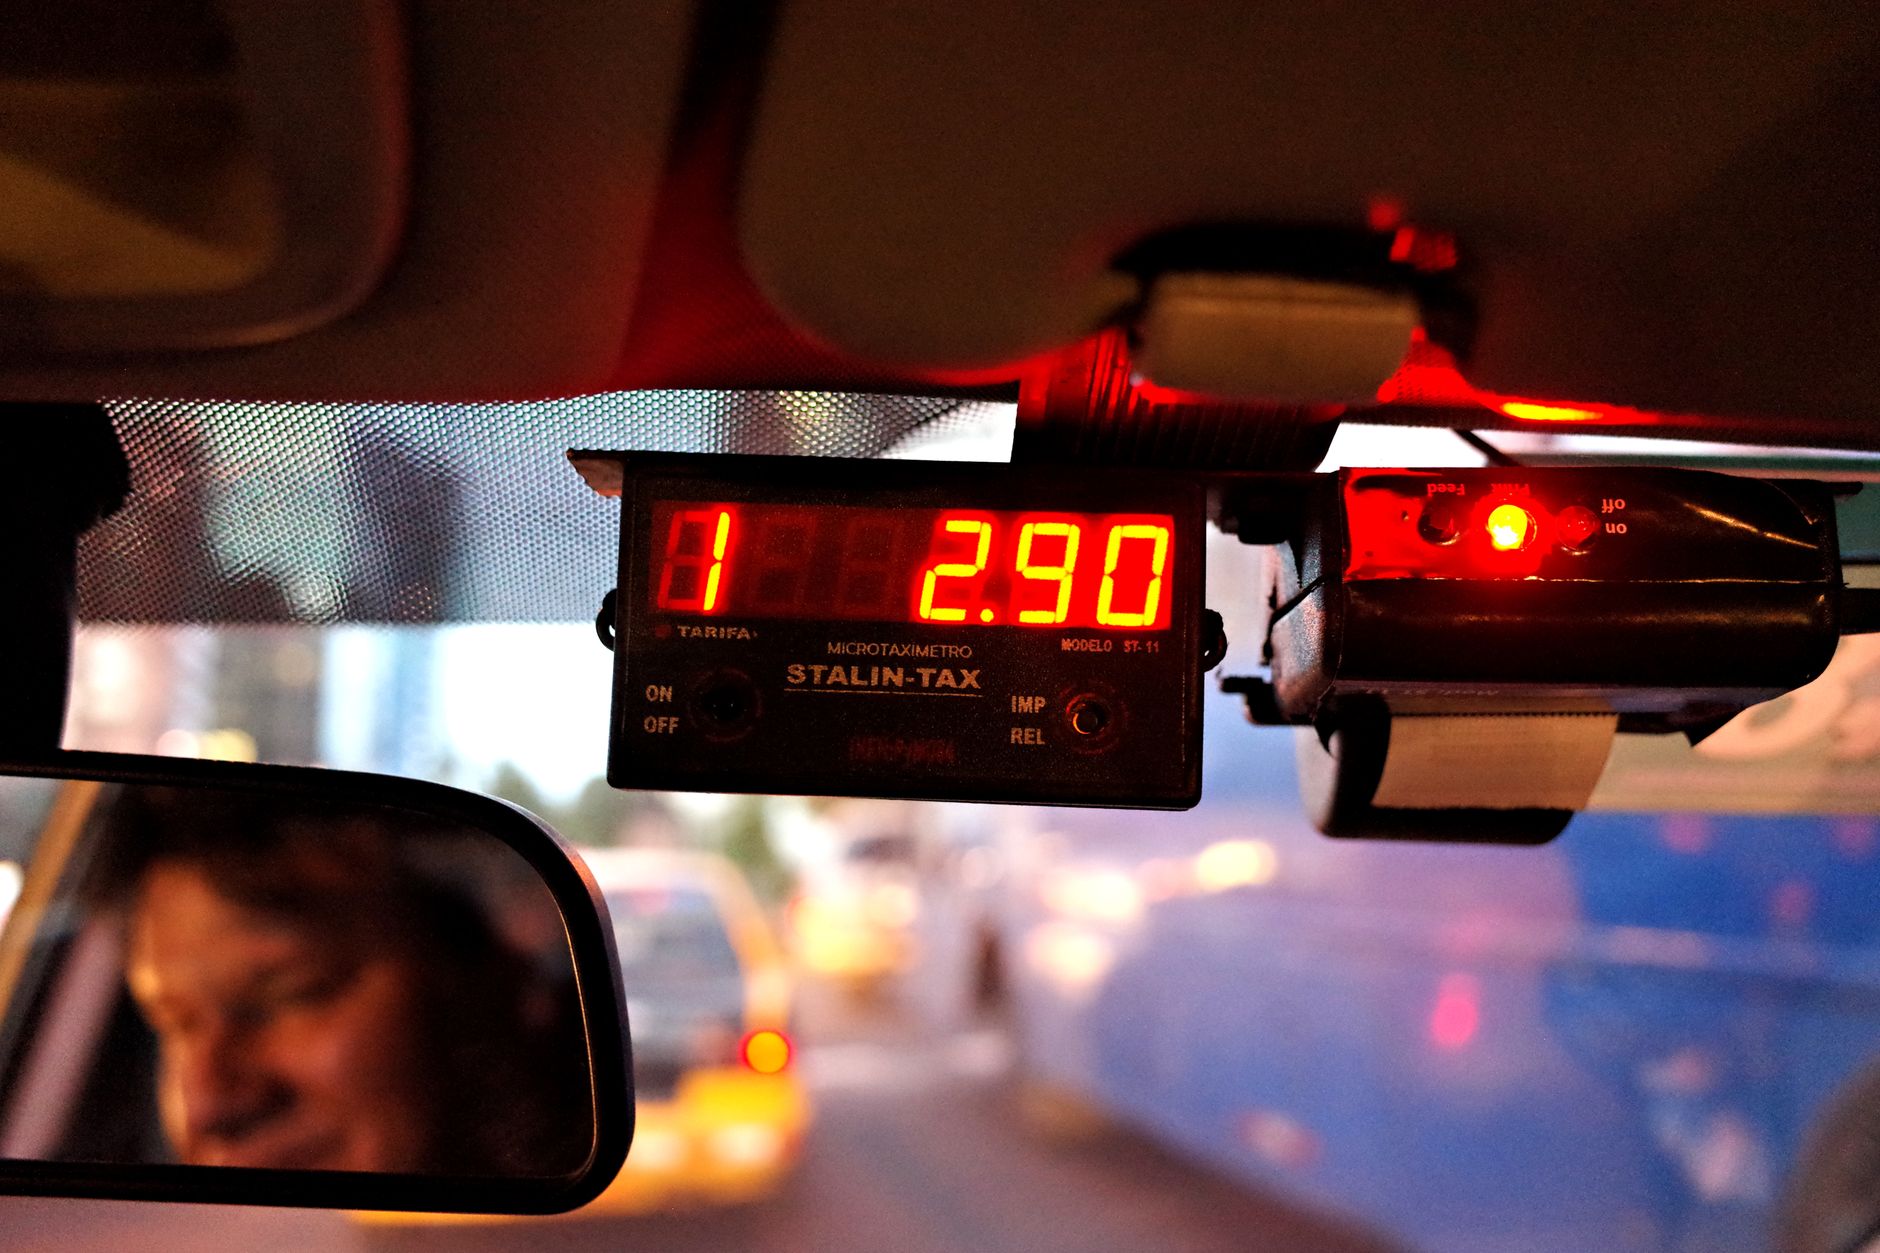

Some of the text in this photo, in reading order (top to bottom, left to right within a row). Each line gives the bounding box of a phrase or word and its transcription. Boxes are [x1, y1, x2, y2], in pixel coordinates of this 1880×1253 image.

[1427, 483, 1465, 497] Feed
[1601, 498, 1626, 513] off
[1605, 523, 1627, 534] on
[702, 511, 731, 611] 1
[919, 519, 1169, 627] 2.90
[677, 625, 751, 640] TARIFA
[1061, 638, 1113, 652] MODELO
[786, 663, 982, 689] STALIN-TAX
[645, 684, 673, 702] ON
[1011, 695, 1046, 713] IMP
[643, 716, 680, 734] OFF
[1010, 727, 1046, 744] REL
